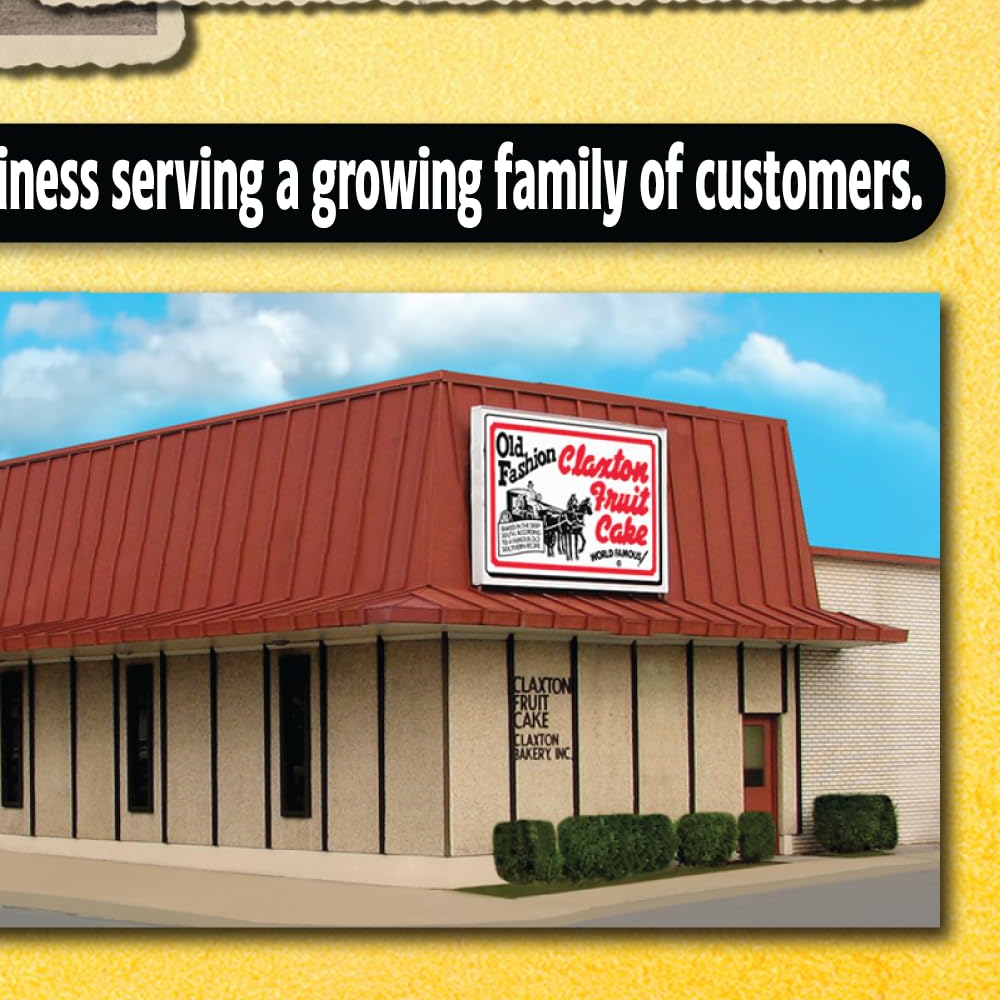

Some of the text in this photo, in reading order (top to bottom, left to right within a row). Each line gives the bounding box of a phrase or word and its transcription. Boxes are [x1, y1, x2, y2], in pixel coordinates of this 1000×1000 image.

[496, 431, 525, 458] Old
[498, 447, 556, 486] Fashion
[558, 443, 649, 483] Claxton
[590, 481, 650, 515] Fruit
[595, 514, 648, 546] Cake
[514, 676, 572, 695] CLAXTON
[514, 694, 549, 711] FRUIT
[514, 712, 549, 729] CAKE
[514, 733, 559, 747] CLAXTON
